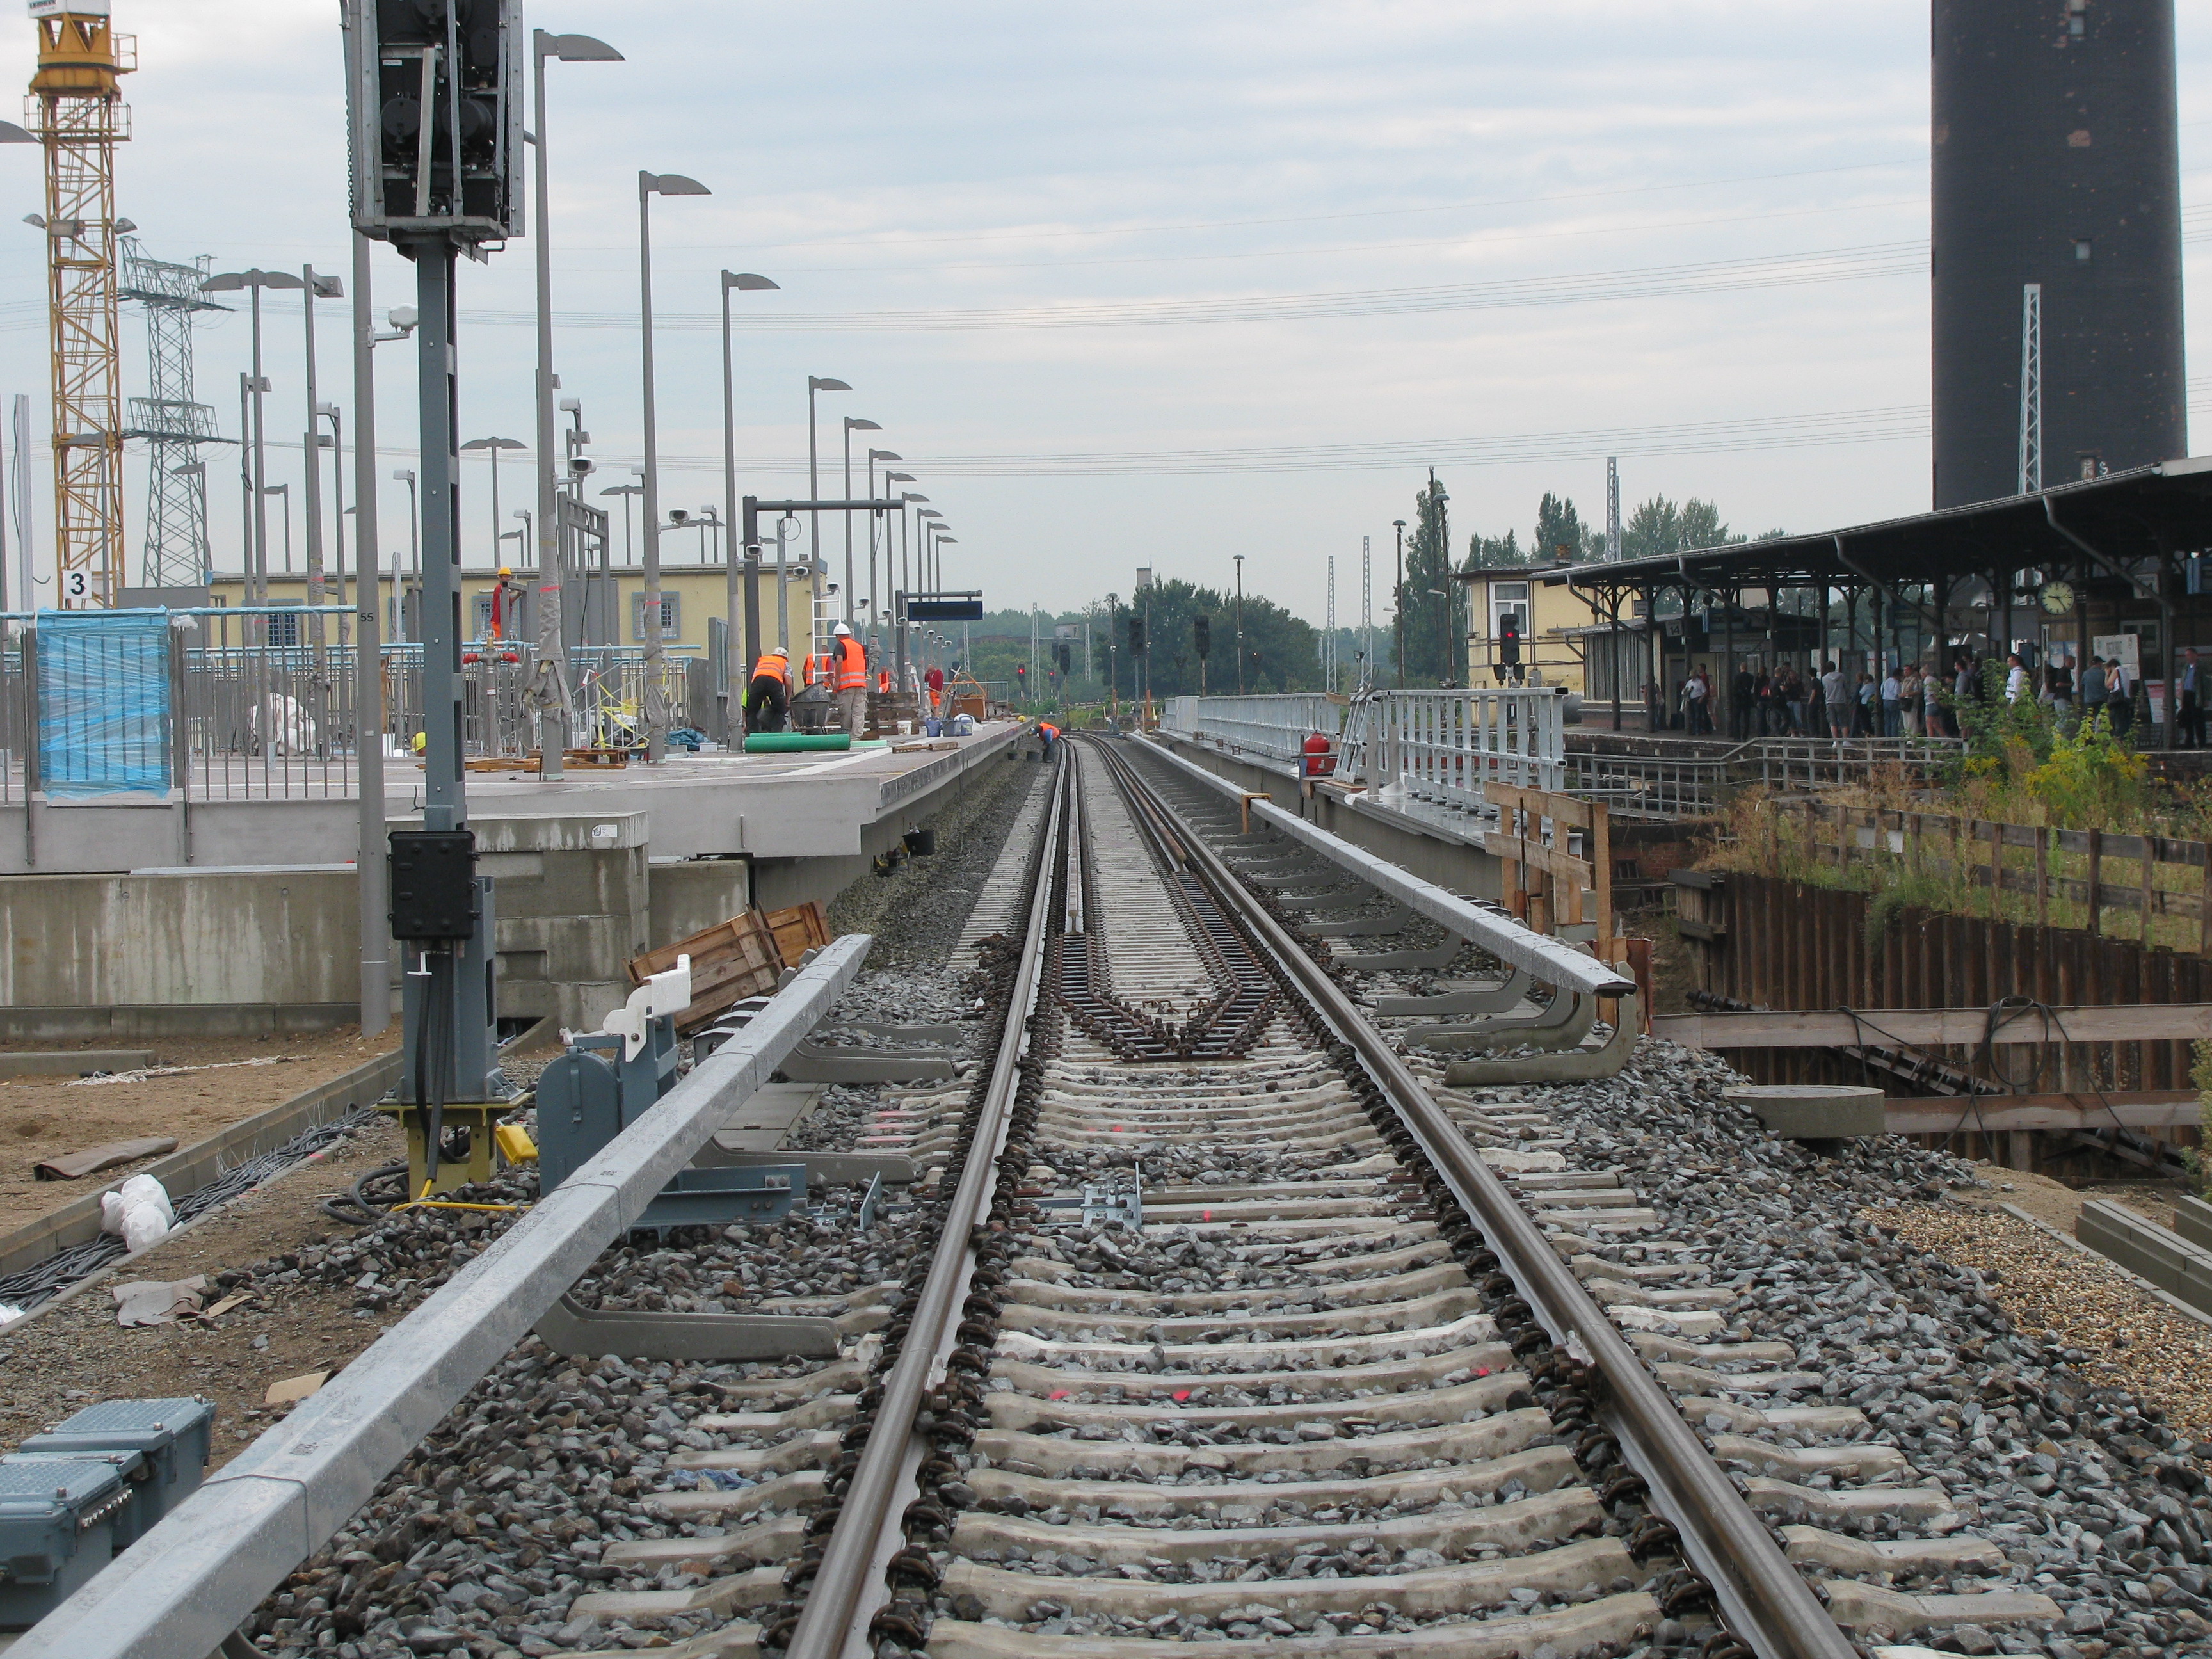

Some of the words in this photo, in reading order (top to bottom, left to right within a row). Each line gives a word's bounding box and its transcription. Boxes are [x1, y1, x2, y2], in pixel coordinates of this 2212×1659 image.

[70, 573, 84, 595] 3
[360, 613, 374, 621] 55
[1670, 625, 1680, 636] 14
